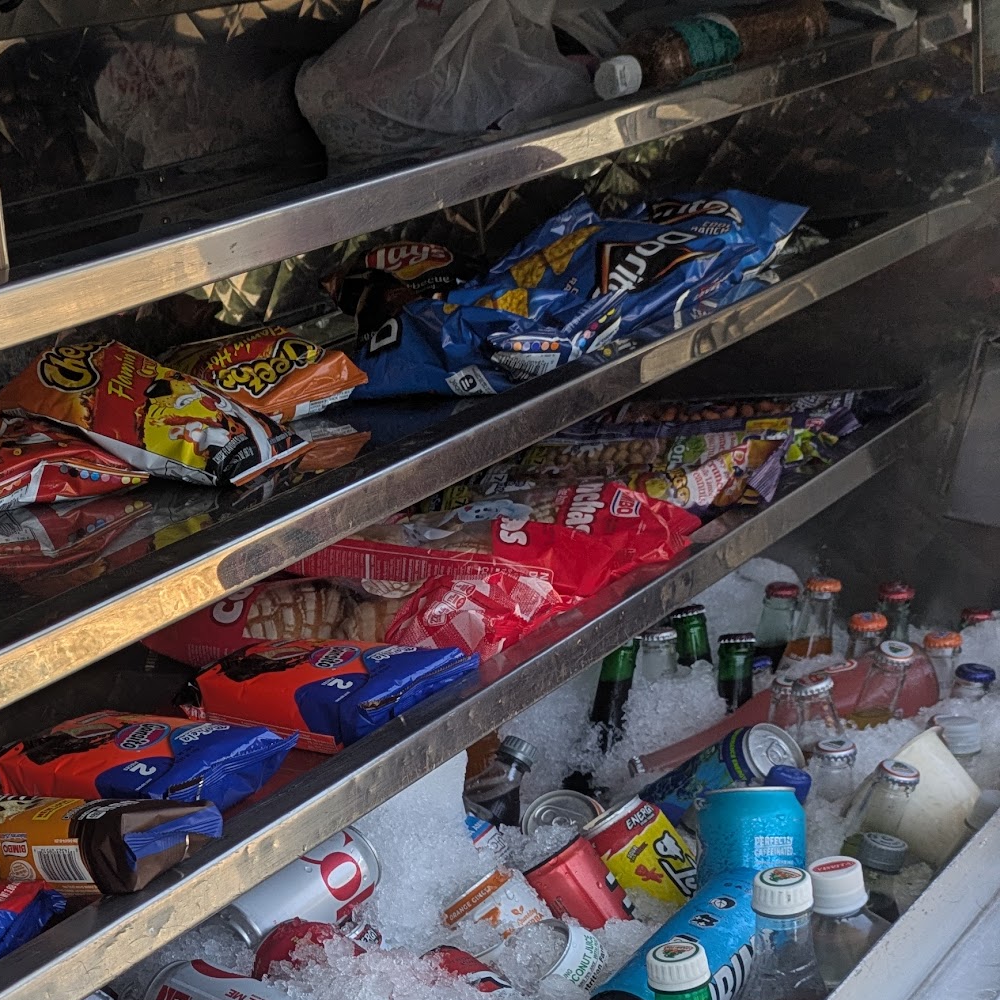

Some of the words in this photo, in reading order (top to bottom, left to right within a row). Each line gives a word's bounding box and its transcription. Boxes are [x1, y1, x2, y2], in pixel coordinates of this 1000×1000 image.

[330, 679, 354, 690] 2
[120, 723, 171, 748] Gansito
[133, 763, 157, 777] 2
[754, 836, 794, 846] PERFECTLY
[3, 843, 27, 855] BIMBO
[449, 902, 472, 921] ORANGE
